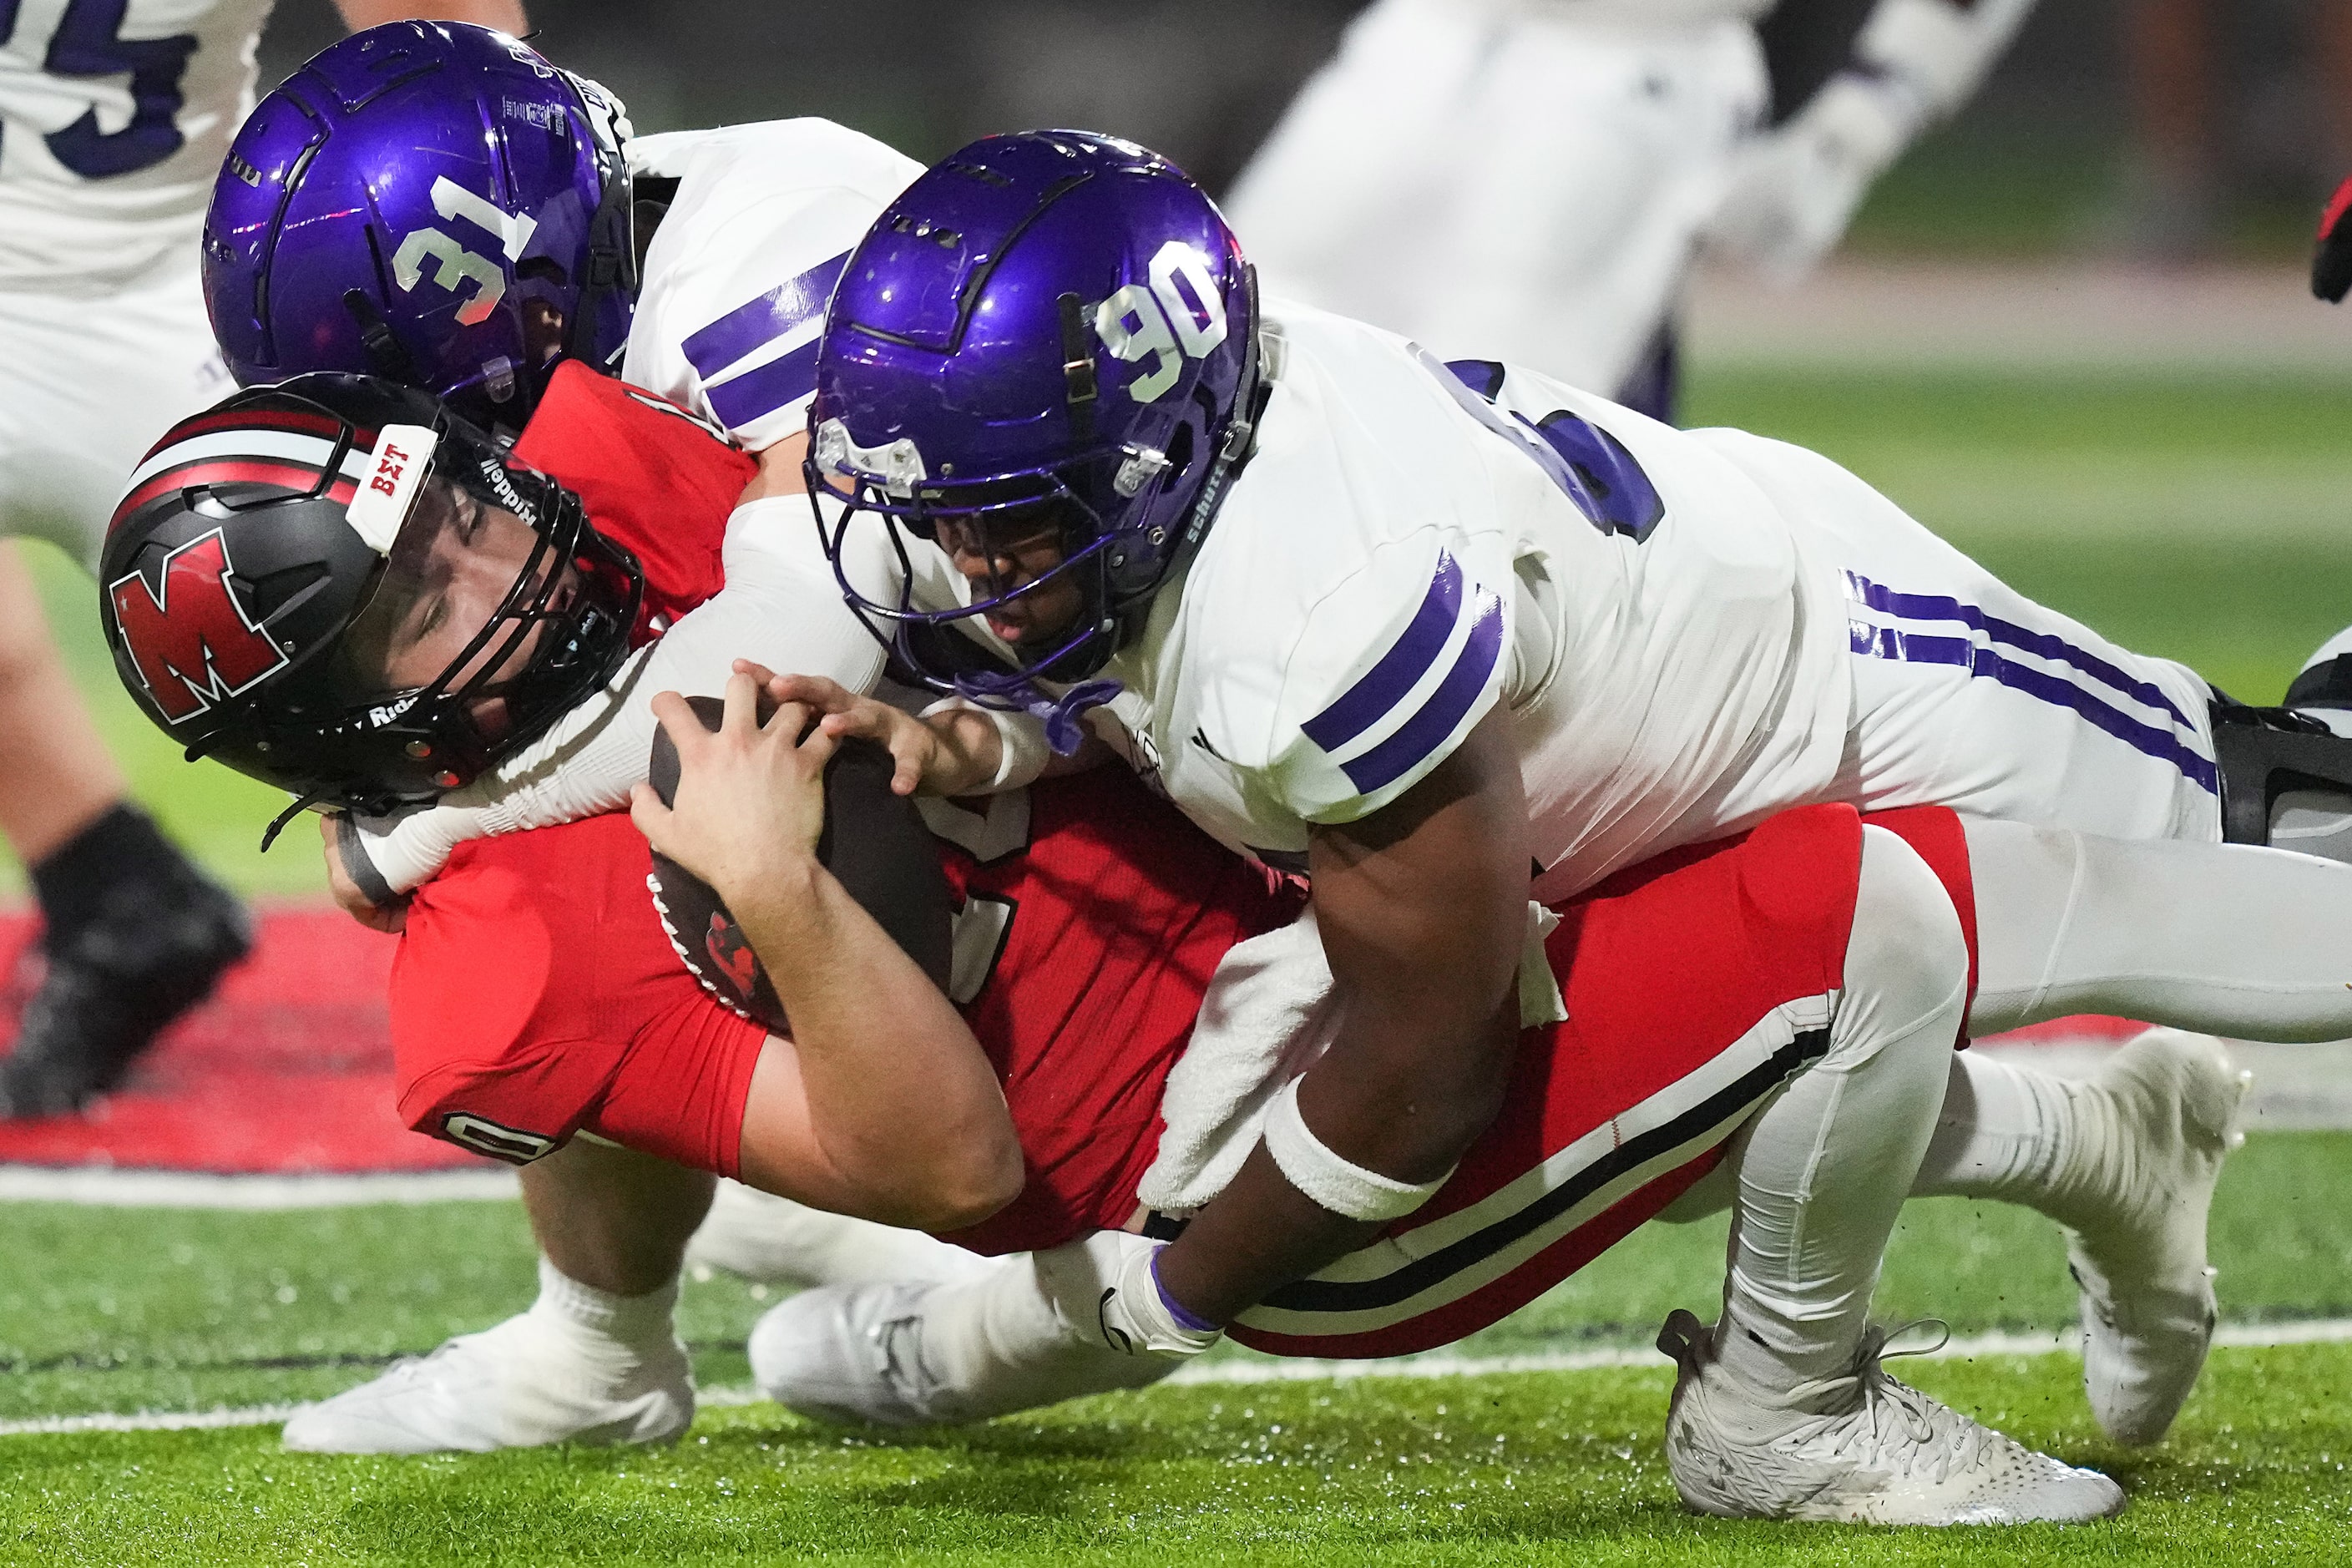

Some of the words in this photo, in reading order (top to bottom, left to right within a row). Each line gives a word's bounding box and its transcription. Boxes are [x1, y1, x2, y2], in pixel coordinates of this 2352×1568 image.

[392, 175, 538, 327] 31
[1095, 240, 1228, 404] 90
[480, 458, 538, 528] Riddell
[109, 526, 291, 726] M
